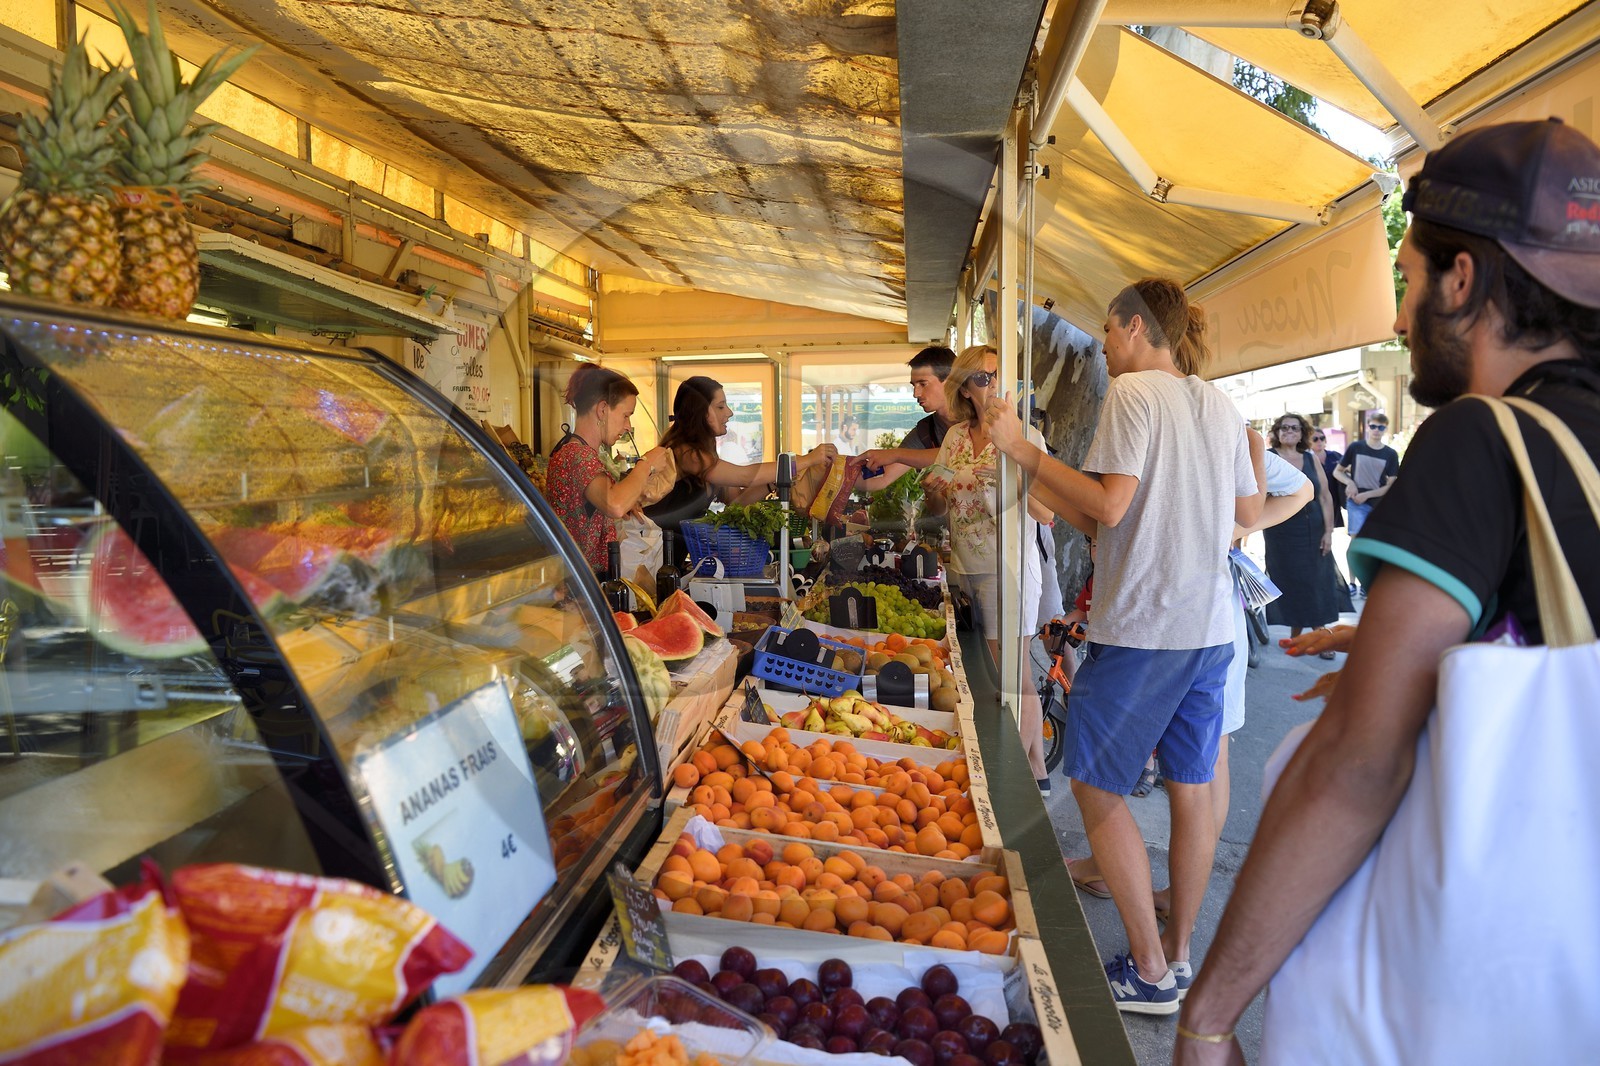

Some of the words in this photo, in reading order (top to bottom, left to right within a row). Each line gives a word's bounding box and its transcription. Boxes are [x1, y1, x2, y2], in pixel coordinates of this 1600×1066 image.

[399, 766, 460, 826] ANANAS
[459, 741, 498, 780] FRAIS
[502, 833, 517, 859] 4€
